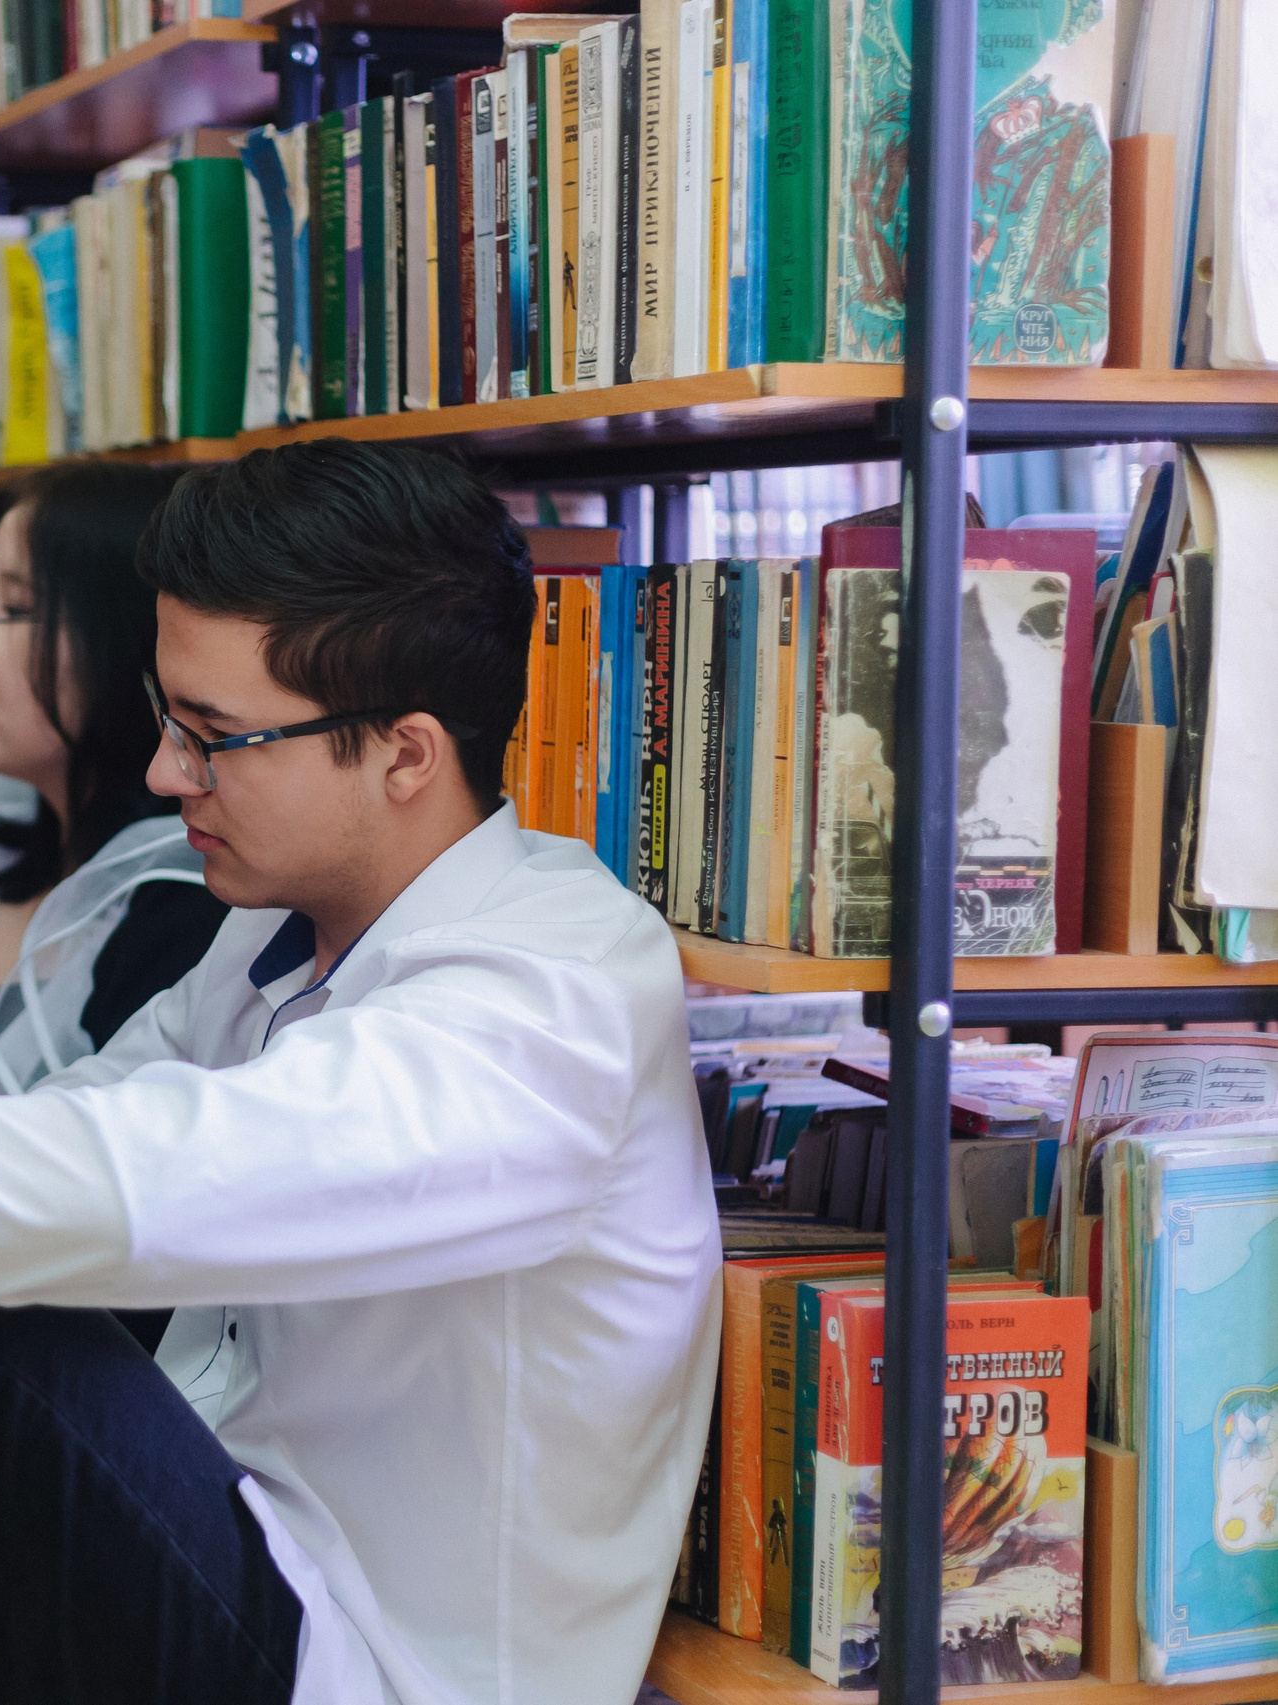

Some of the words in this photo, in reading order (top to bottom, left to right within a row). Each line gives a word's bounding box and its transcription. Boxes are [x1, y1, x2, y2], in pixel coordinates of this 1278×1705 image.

[644, 45, 662, 246] ПРИКЛЮЧЕНИЙ
[621, 174, 630, 272] фантастическая
[644, 262, 659, 319] МИР
[1021, 310, 1052, 321] КРУГ
[619, 276, 627, 366] Американская
[1020, 336, 1049, 346] НИЯ
[1022, 323, 1049, 334] ЧТЕ-
[654, 580, 671, 729] МАРИНИНА
[700, 660, 712, 735] СТЮАРТ
[653, 732, 668, 758] А.
[699, 741, 708, 791] Мэри
[707, 690, 720, 802] ИСЧЕЗНУВШИЙ
[638, 781, 652, 903] ЖЮЛЬ
[706, 806, 715, 849] Нибел
[702, 851, 713, 906] Флетчер
[975, 878, 1037, 889] ЧЕРНЯК
[830, 1322, 837, 1335] 6
[980, 1317, 1016, 1330] ВЕРН
[870, 1345, 1065, 1385] ТТВЕННЫЙ
[824, 1365, 833, 1445] БИБЛИОТЕКА
[944, 1390, 1049, 1439] ТРОВ
[732, 1430, 744, 1498] ВЕТРОМ
[829, 1492, 837, 1537] ОСТРОВ
[817, 1595, 826, 1634] ЖЮЛЬ
[825, 1542, 836, 1638] ТАИНСТВЕННЫЙ
